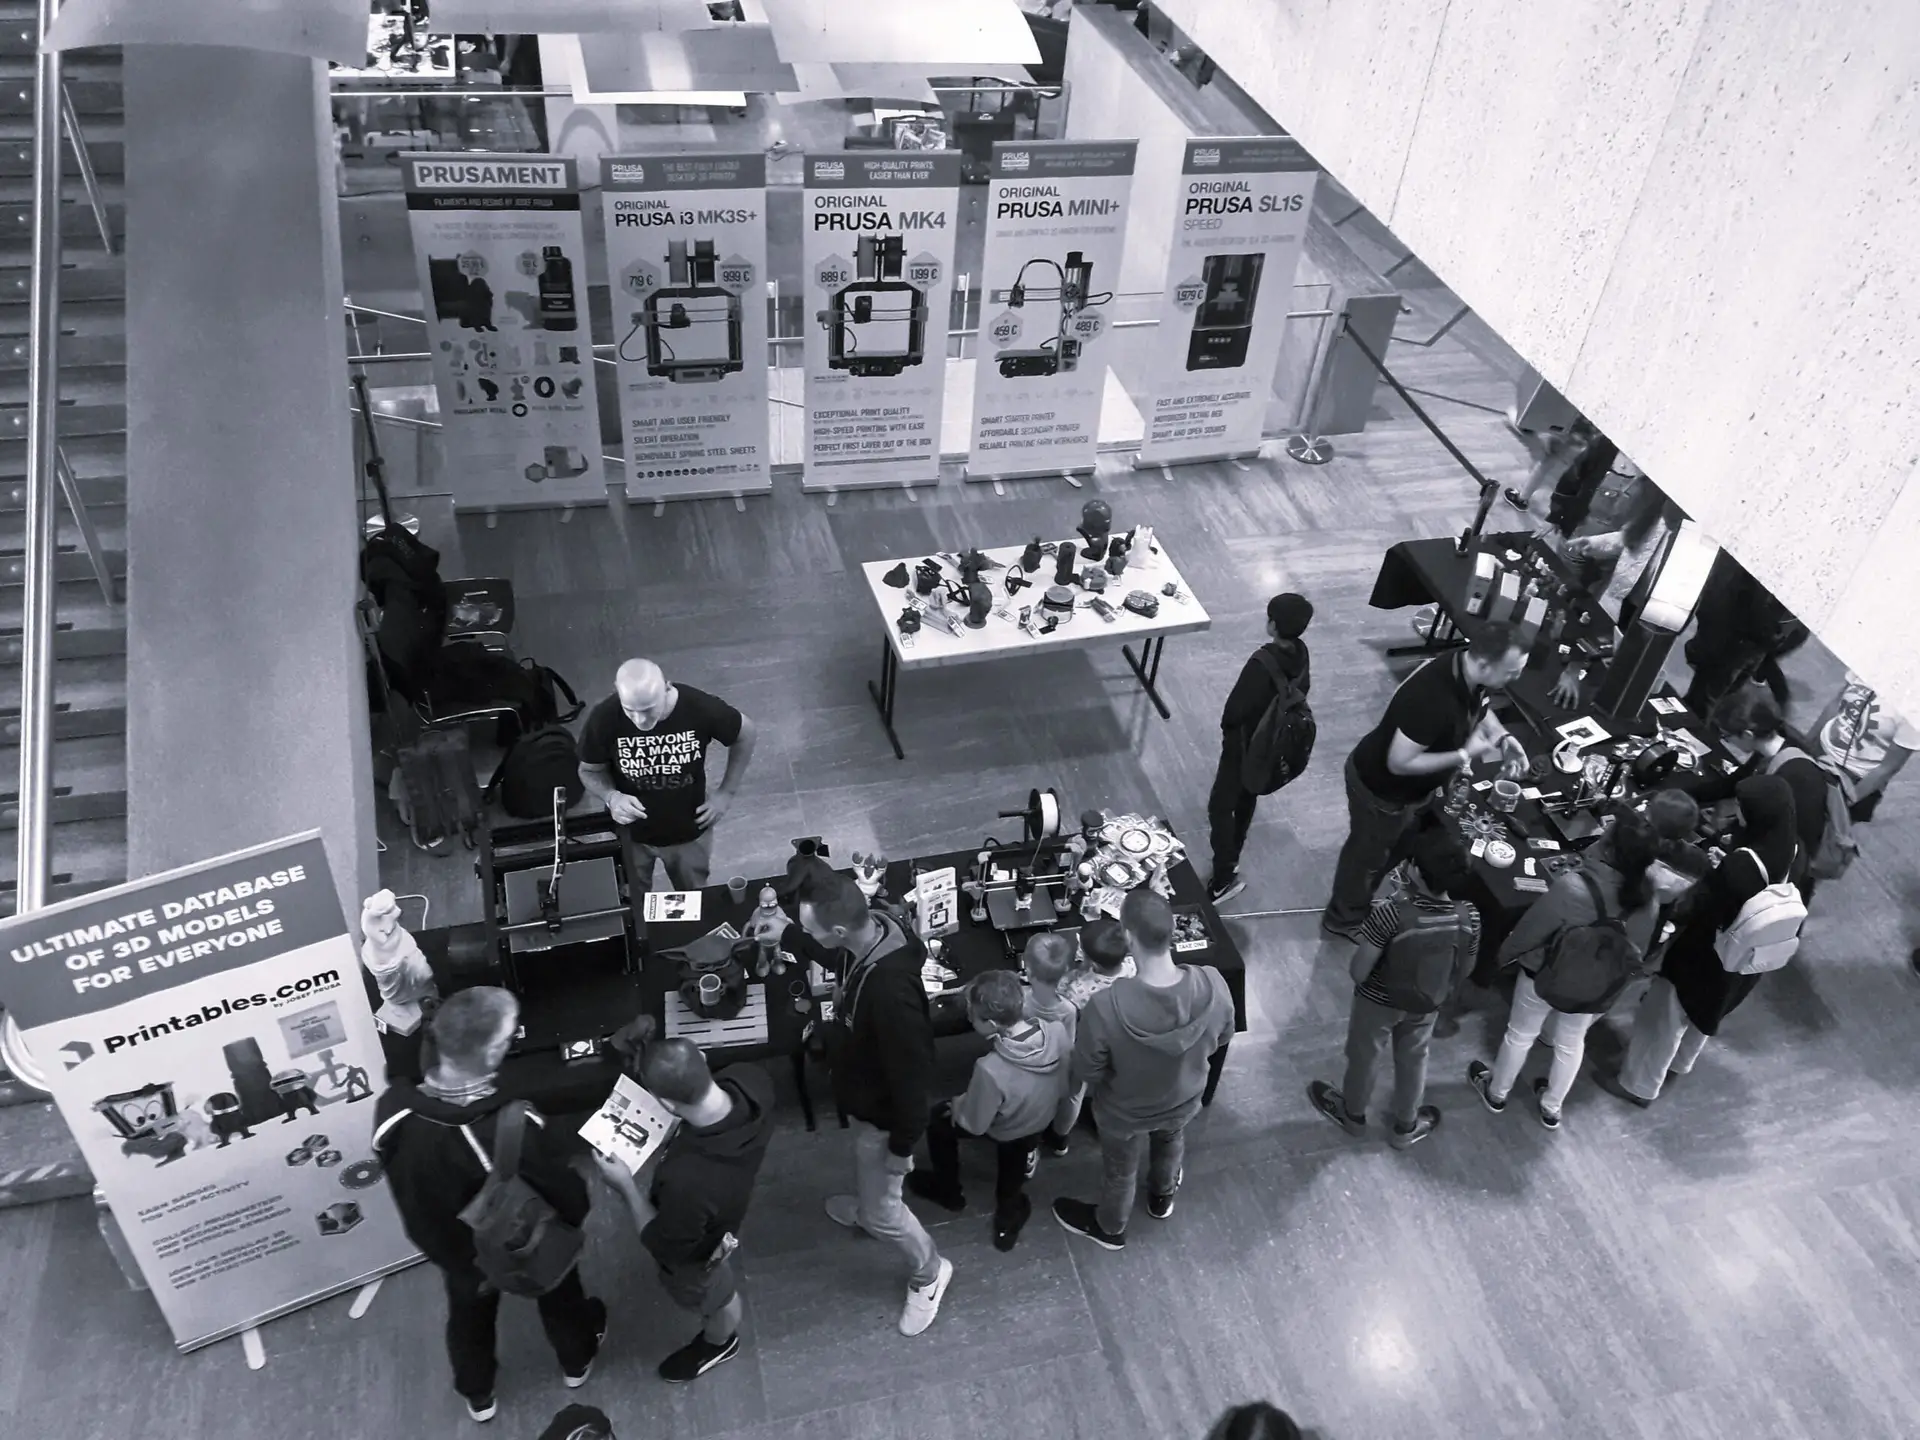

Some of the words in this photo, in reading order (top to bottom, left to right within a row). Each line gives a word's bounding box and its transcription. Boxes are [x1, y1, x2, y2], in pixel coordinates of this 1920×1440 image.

[1001, 152, 1030, 160] PRUSA
[612, 164, 643, 172] PRUSA
[814, 161, 845, 169] PRUSA
[864, 161, 909, 170] HIGH-QUALITY
[418, 165, 562, 184] PRUSAMENT
[869, 171, 892, 180] EASIER
[894, 171, 911, 180] THAN
[912, 171, 930, 180] EVER
[999, 186, 1061, 198] ORIGINAL
[1189, 180, 1252, 194] ORIGINAL
[614, 200, 670, 211] ORIGINAL
[815, 195, 888, 208] ORIGINAL
[1185, 196, 1253, 215] PRUSA
[1258, 194, 1304, 212] SL1S
[997, 201, 1063, 219] PRUSA
[1067, 199, 1120, 216] MINI+
[615, 212, 676, 227] PRUSA
[680, 211, 694, 225] i3
[698, 210, 757, 224] MK3S+
[814, 212, 893, 231] PRUSA
[899, 211, 947, 230] MK4
[1183, 218, 1223, 231] SPEED
[723, 271, 741, 282] 999
[860, 408, 881, 417] PRINT
[883, 407, 911, 416] QUALITY
[908, 422, 926, 430] EASE
[617, 730, 696, 748] EVERYONE
[618, 748, 632, 759] IS
[635, 748, 646, 758] A
[649, 740, 701, 756] MAKER
[620, 755, 657, 769] ONLY
[660, 755, 665, 764] I
[668, 753, 690, 764] AM
[693, 750, 702, 761] A
[10, 909, 157, 963] ULTIMATE
[162, 865, 306, 920] DATABASE
[65, 949, 105, 971] OF
[115, 936, 152, 958] 3D
[157, 899, 275, 945] MODELS
[72, 965, 133, 994] FOR
[138, 918, 284, 974] EVERYONE
[103, 969, 340, 1053] Printables.com
